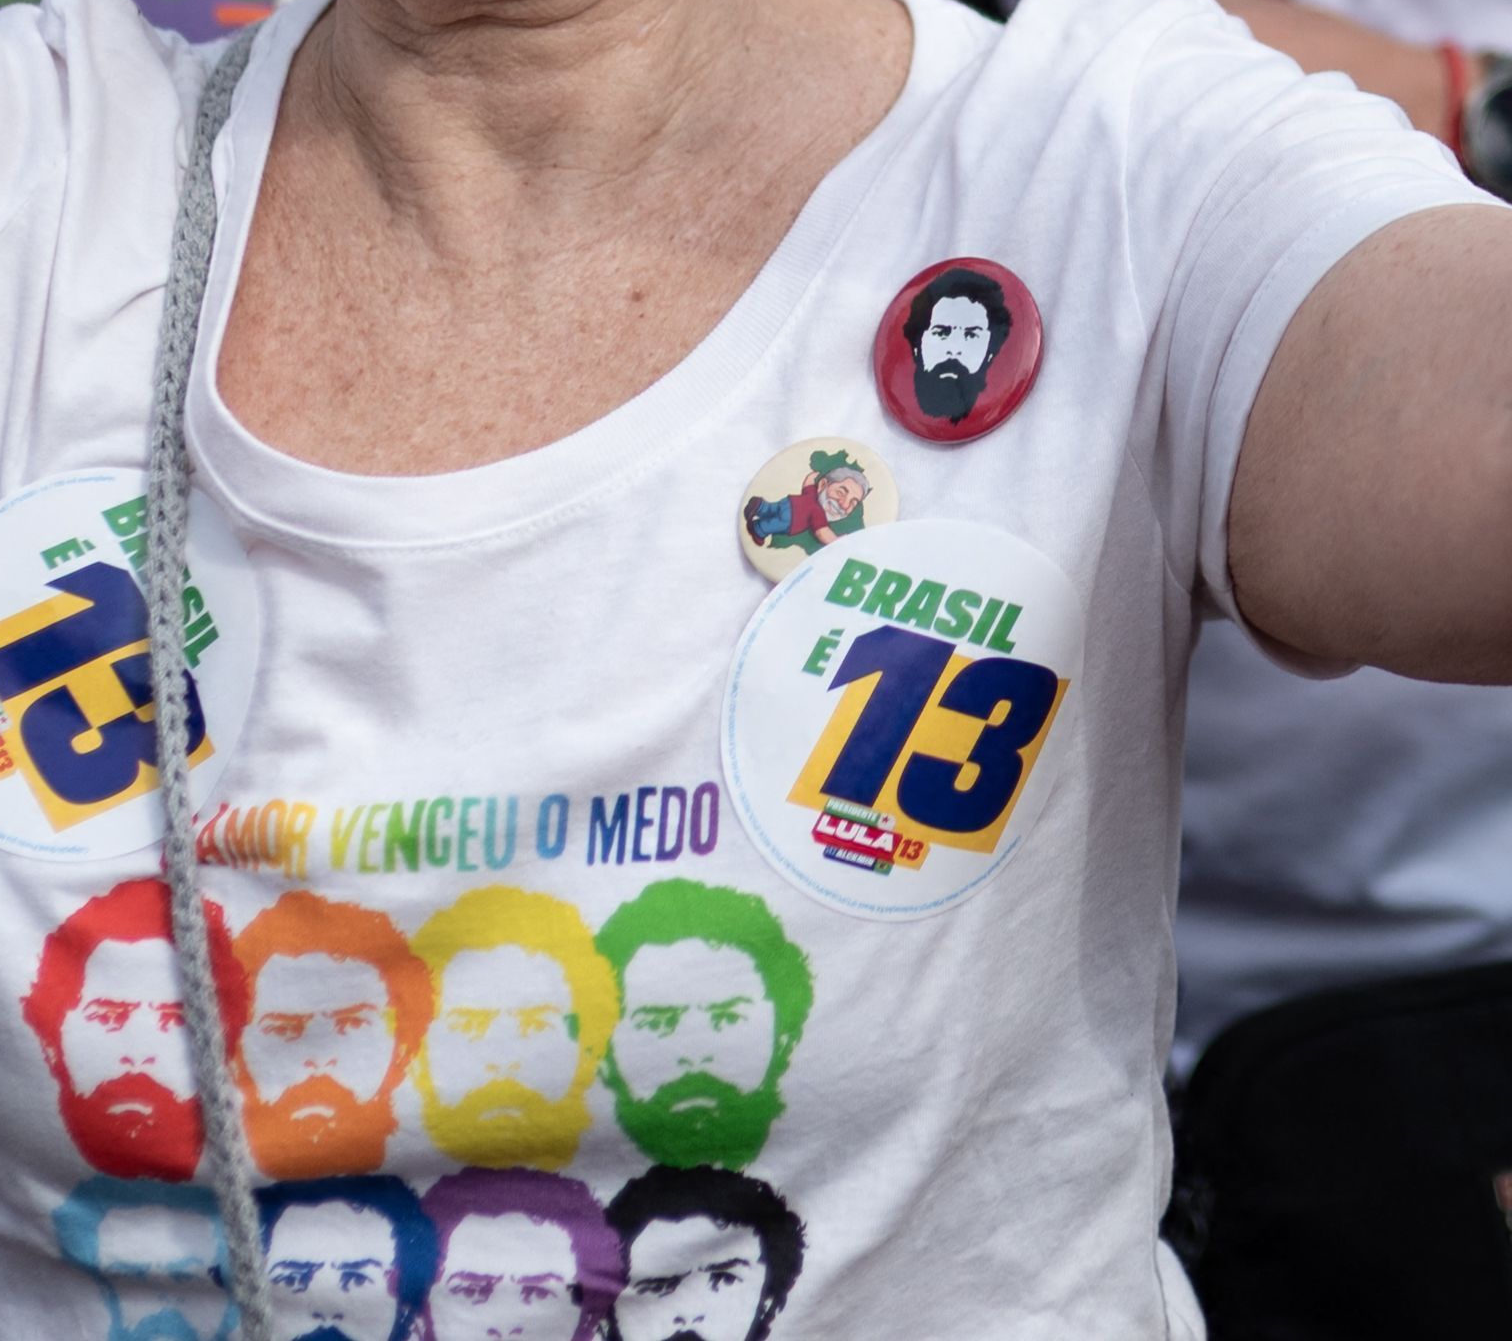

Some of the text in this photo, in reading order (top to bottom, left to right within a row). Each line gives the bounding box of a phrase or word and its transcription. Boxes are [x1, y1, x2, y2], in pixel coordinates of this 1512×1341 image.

[40, 537, 96, 570] É
[101, 492, 220, 669] BRSIL
[801, 628, 845, 677] É
[824, 557, 1023, 655] BRASIL
[819, 624, 1058, 833] 13
[195, 798, 318, 880] AMOR
[330, 793, 519, 874] VENCEU
[536, 792, 571, 860] O
[586, 780, 720, 867] MEDO
[815, 814, 894, 853] LULA
[898, 838, 925, 862] 13
